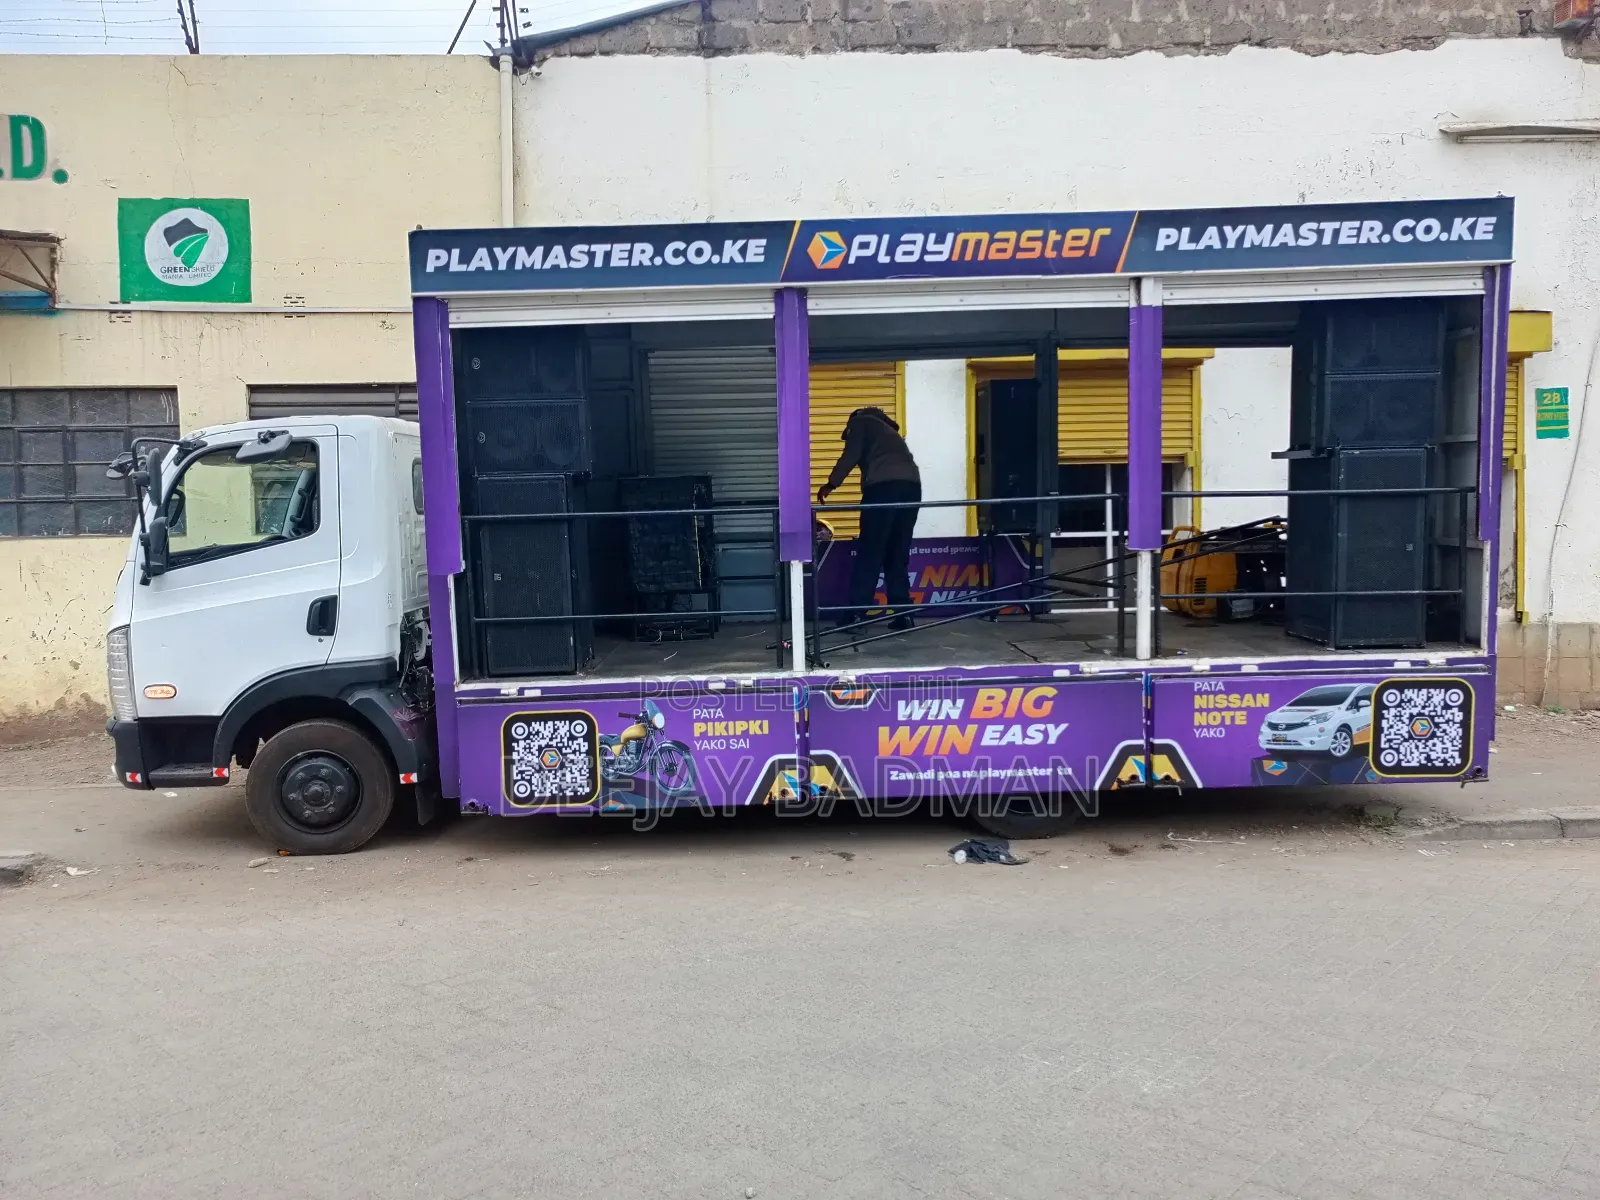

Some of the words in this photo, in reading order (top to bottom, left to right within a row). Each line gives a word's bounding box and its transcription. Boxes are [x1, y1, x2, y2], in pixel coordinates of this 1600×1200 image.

[1154, 216, 1498, 252] PLAYMASTER.CO.KE
[425, 238, 767, 273] PLAYMASTER.CO.KE
[1543, 392, 1561, 404] 28
[1193, 681, 1225, 692] PATA
[897, 698, 965, 721] WIN
[970, 686, 1059, 719] BIG
[1193, 692, 1270, 709] NISSAN
[692, 708, 724, 719] PATA
[1193, 710, 1248, 726] NOTE
[692, 719, 769, 737] PIKIPKI
[1194, 726, 1226, 738] YAKO
[693, 738, 727, 751] YAKO
[729, 738, 750, 750] SAI
[877, 723, 978, 757] WIN
[980, 721, 1069, 746] EASY
[889, 767, 935, 781] Zawadi
[937, 769, 960, 782] poa
[962, 769, 979, 779] na
[979, 766, 1052, 780] playmaster
